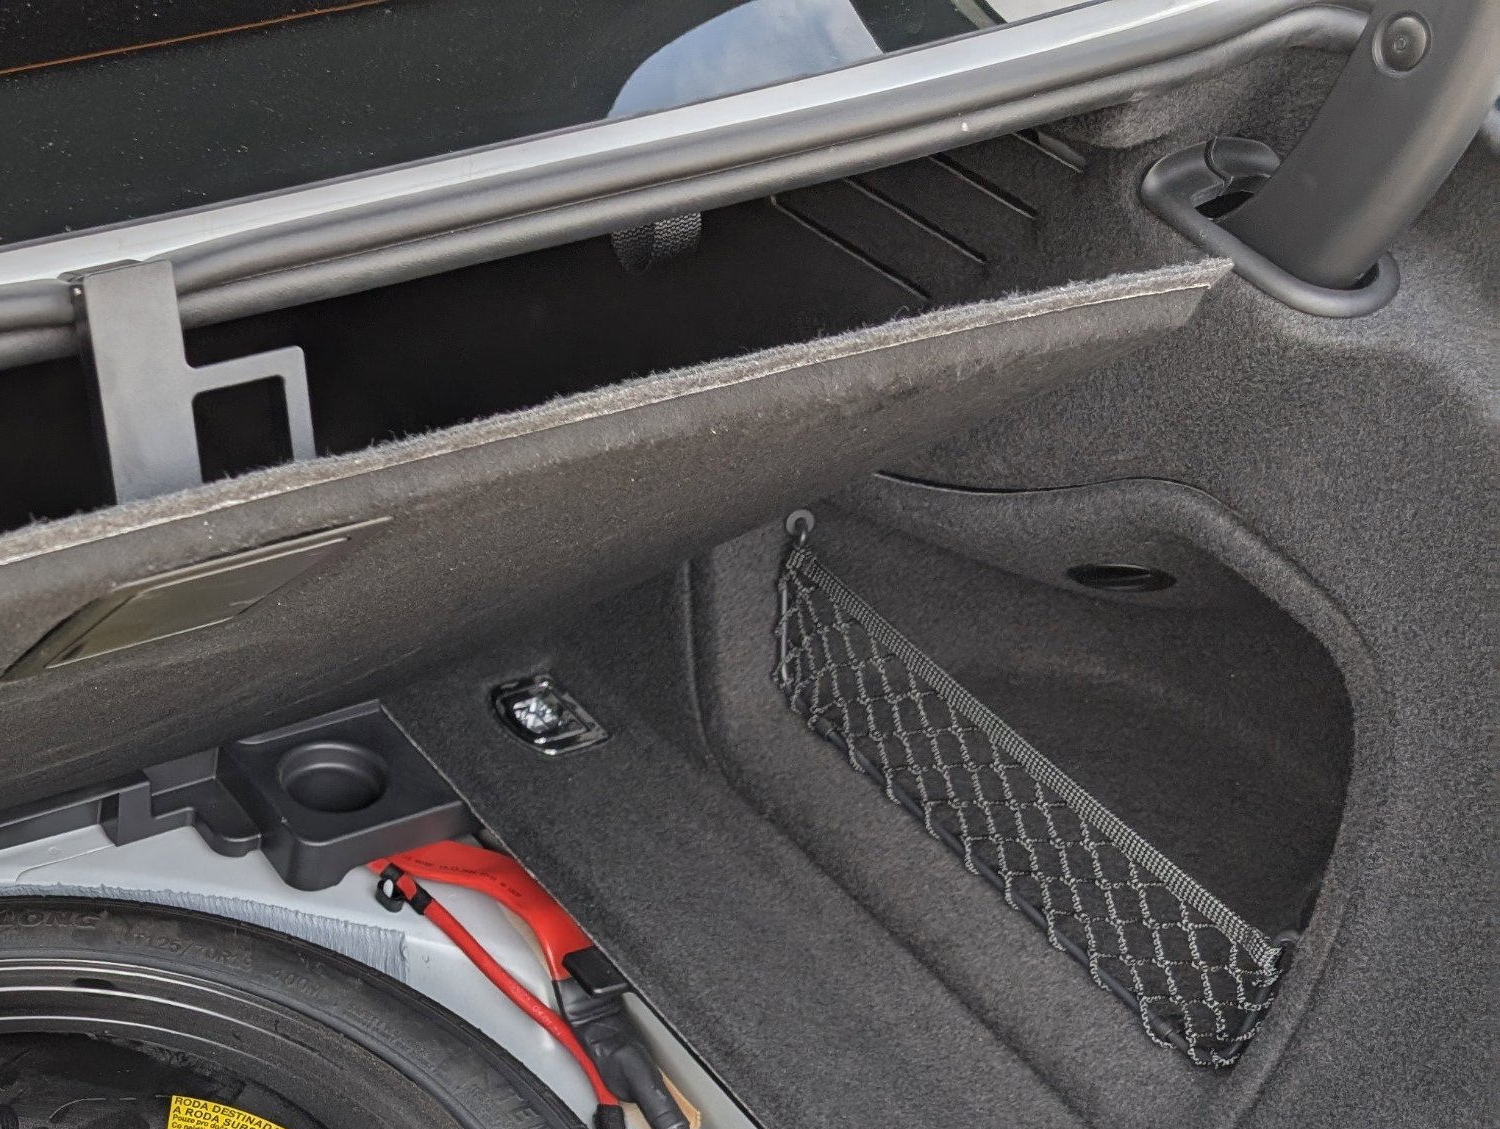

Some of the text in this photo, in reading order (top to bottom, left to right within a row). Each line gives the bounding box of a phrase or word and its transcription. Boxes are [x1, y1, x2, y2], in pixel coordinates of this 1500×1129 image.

[174, 1097, 208, 1110] RODA
[172, 1105, 181, 1114] A
[184, 1107, 219, 1122] RODA
